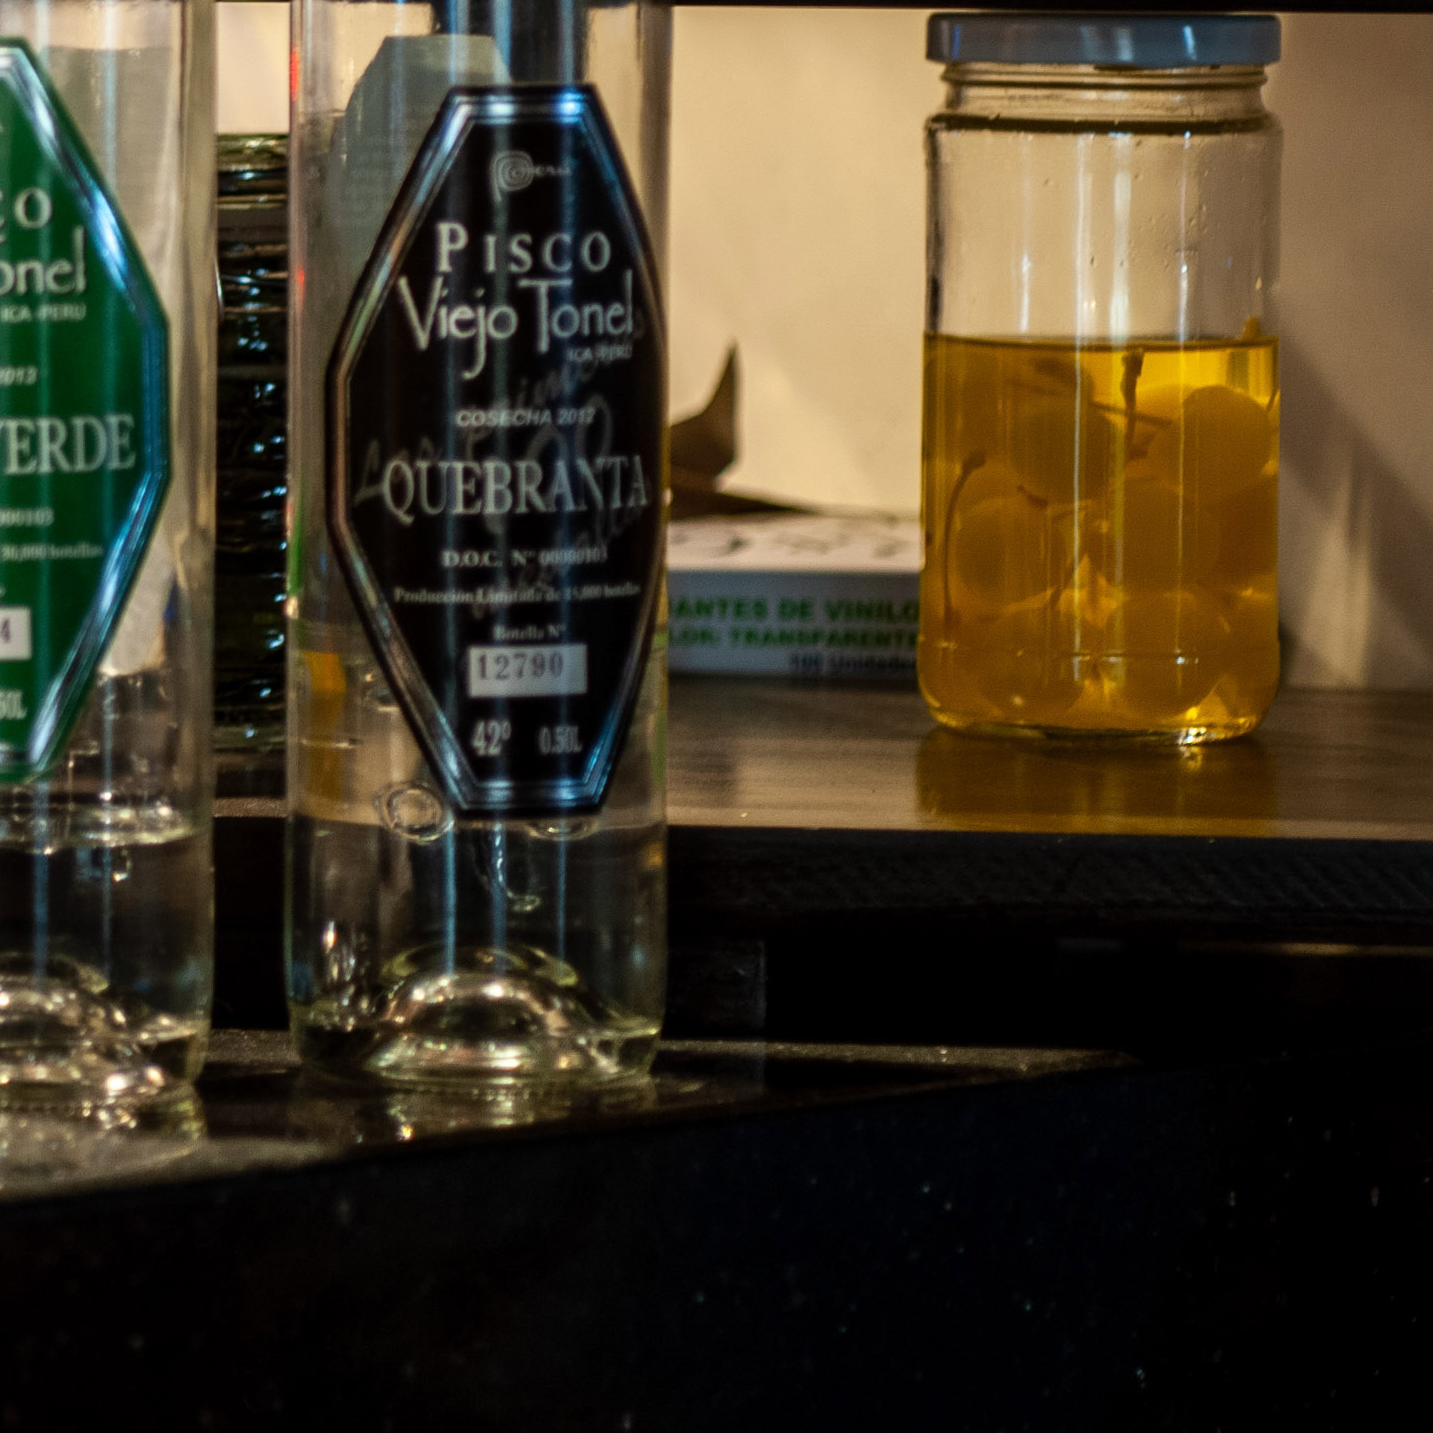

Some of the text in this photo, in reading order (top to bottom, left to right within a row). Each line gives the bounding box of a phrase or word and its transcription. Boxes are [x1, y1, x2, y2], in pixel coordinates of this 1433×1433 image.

[436, 221, 612, 273] PISCO
[398, 268, 634, 379] Viejo Tonel
[454, 409, 552, 427] COSECHA
[383, 455, 648, 526] QUEBRANTA
[670, 597, 768, 620] ANTES
[778, 597, 814, 621] DE
